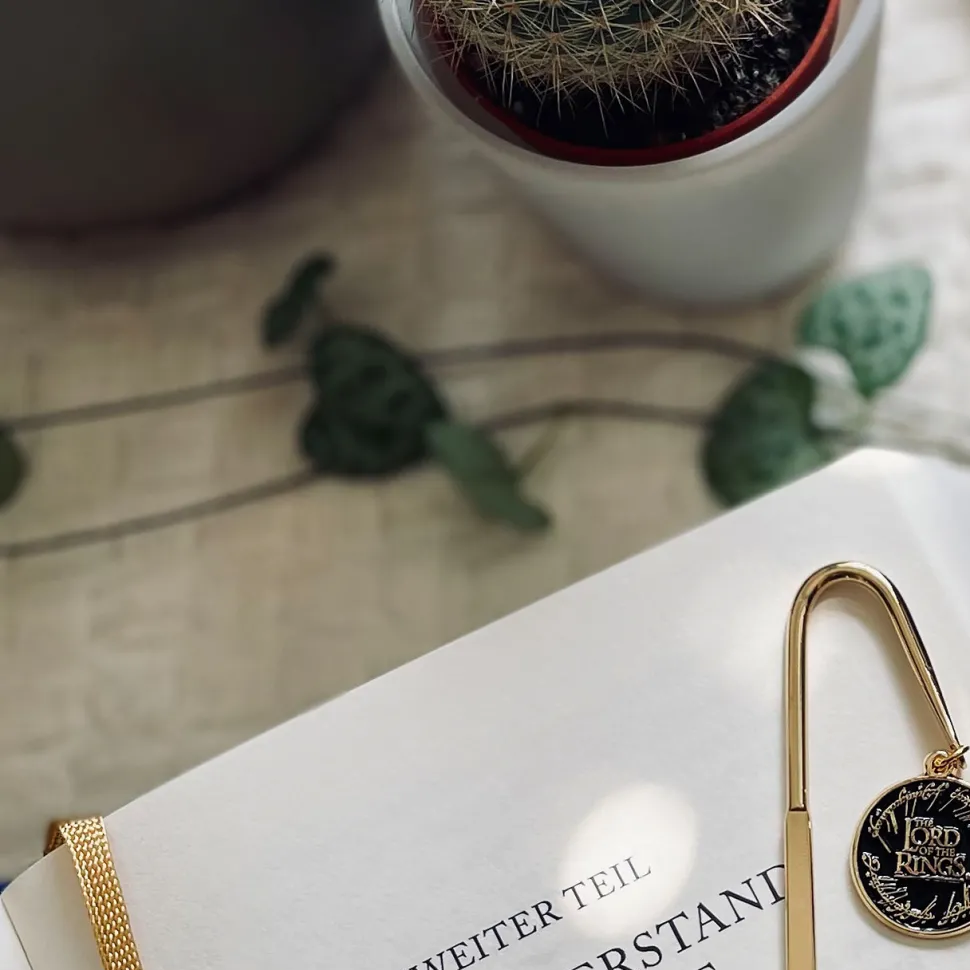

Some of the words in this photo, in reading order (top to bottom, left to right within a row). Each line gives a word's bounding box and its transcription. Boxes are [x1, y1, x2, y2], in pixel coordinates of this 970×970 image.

[902, 817, 961, 852] LORD
[894, 851, 967, 877] RINGS
[919, 846, 934, 856] OF
[935, 846, 956, 857] THE
[562, 855, 652, 911] TEIL
